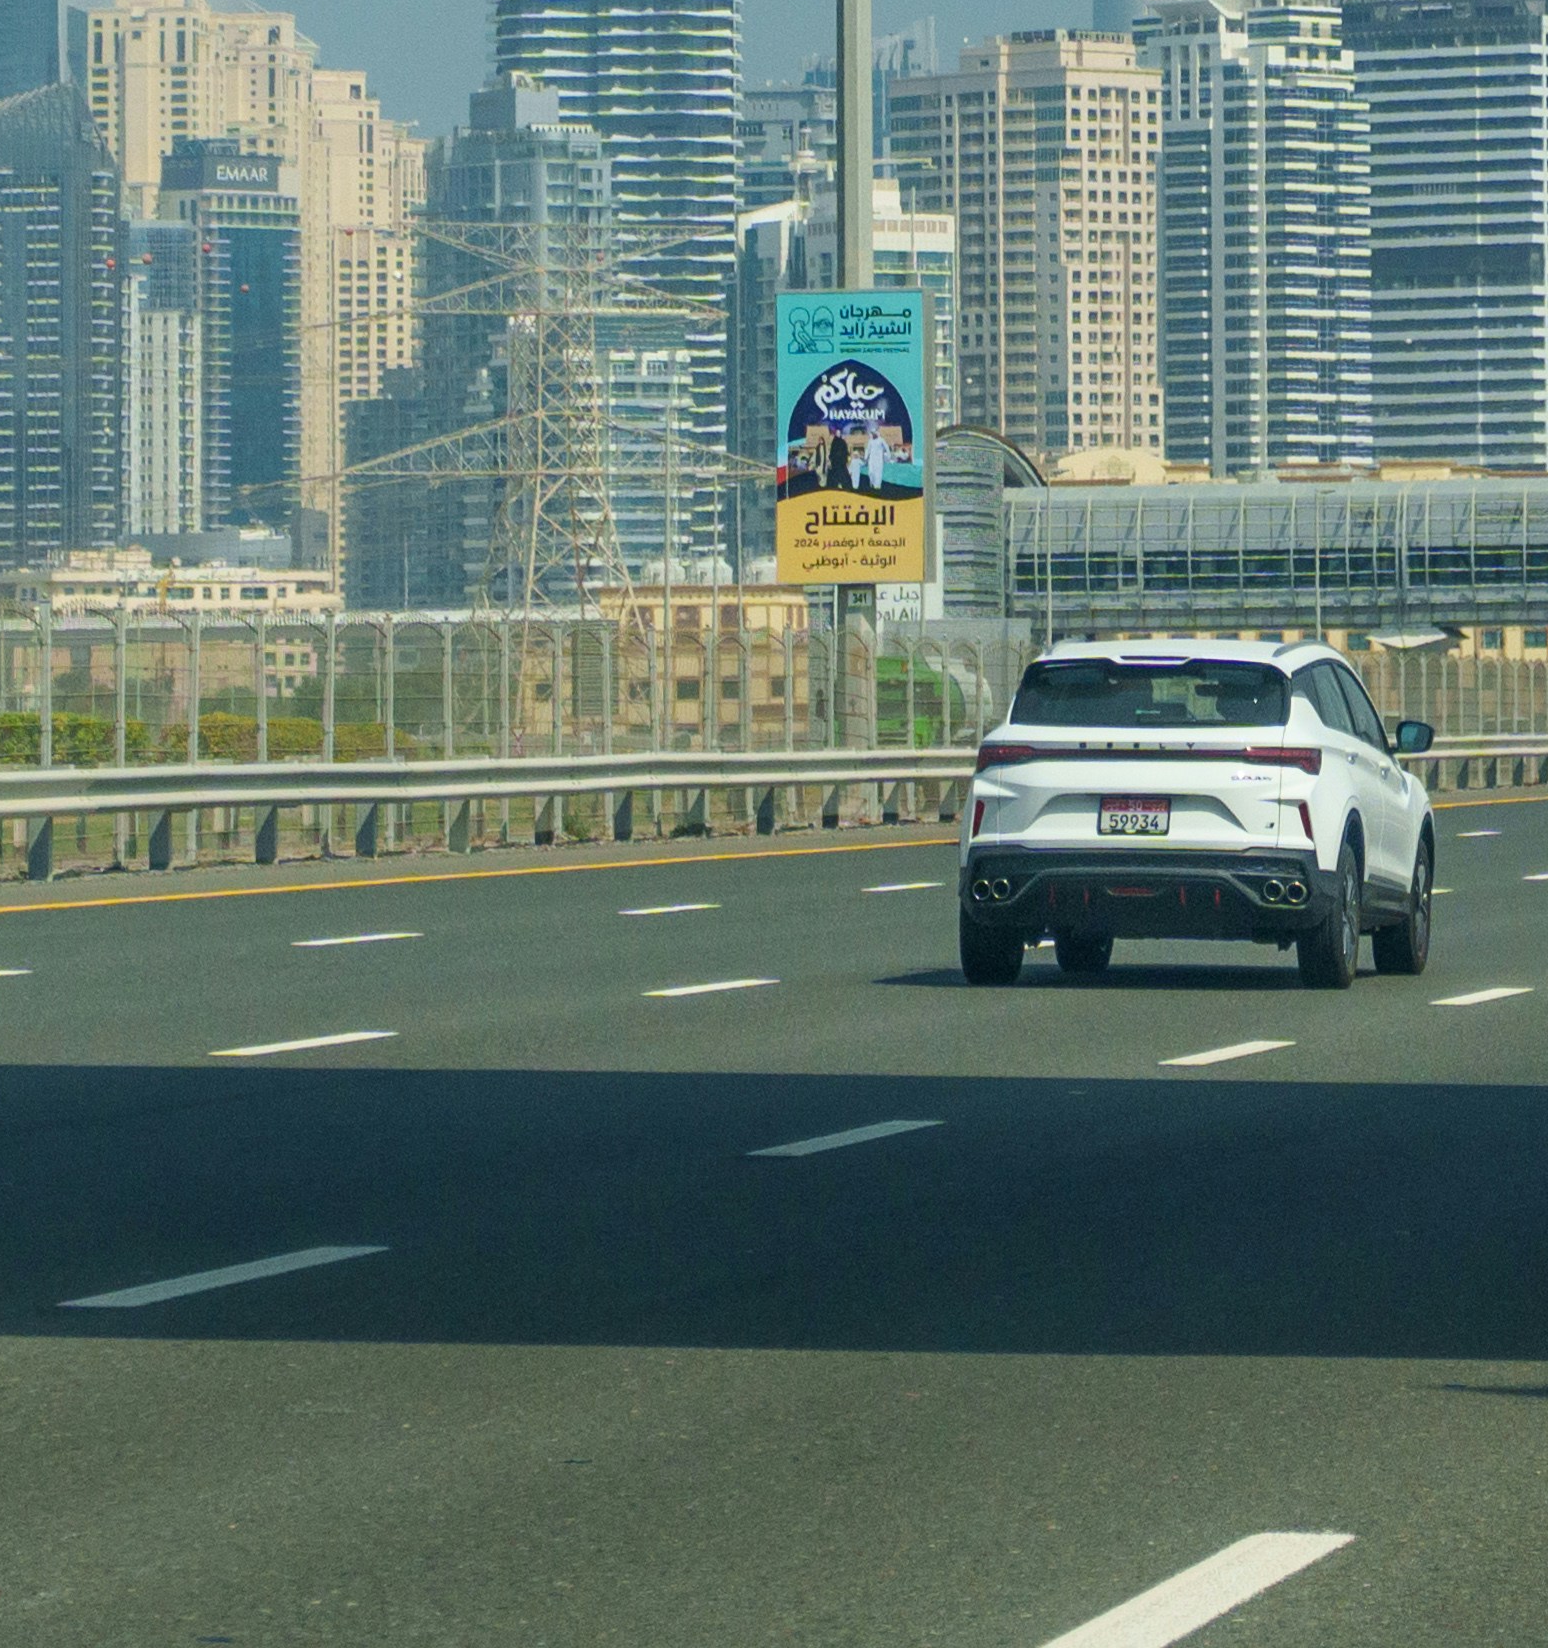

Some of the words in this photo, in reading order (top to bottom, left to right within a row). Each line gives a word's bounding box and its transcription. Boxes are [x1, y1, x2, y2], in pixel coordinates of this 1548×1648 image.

[216, 165, 268, 182] EMAAR
[839, 318, 865, 339] زايد
[868, 321, 912, 339] الشيخ
[829, 408, 886, 420] HAYAKUM
[805, 505, 895, 535] الإفتتاح
[794, 538, 820, 548] 2024
[868, 537, 906, 548] الجمعة
[860, 553, 896, 568] الوثبة
[1109, 814, 1159, 830] 59934
